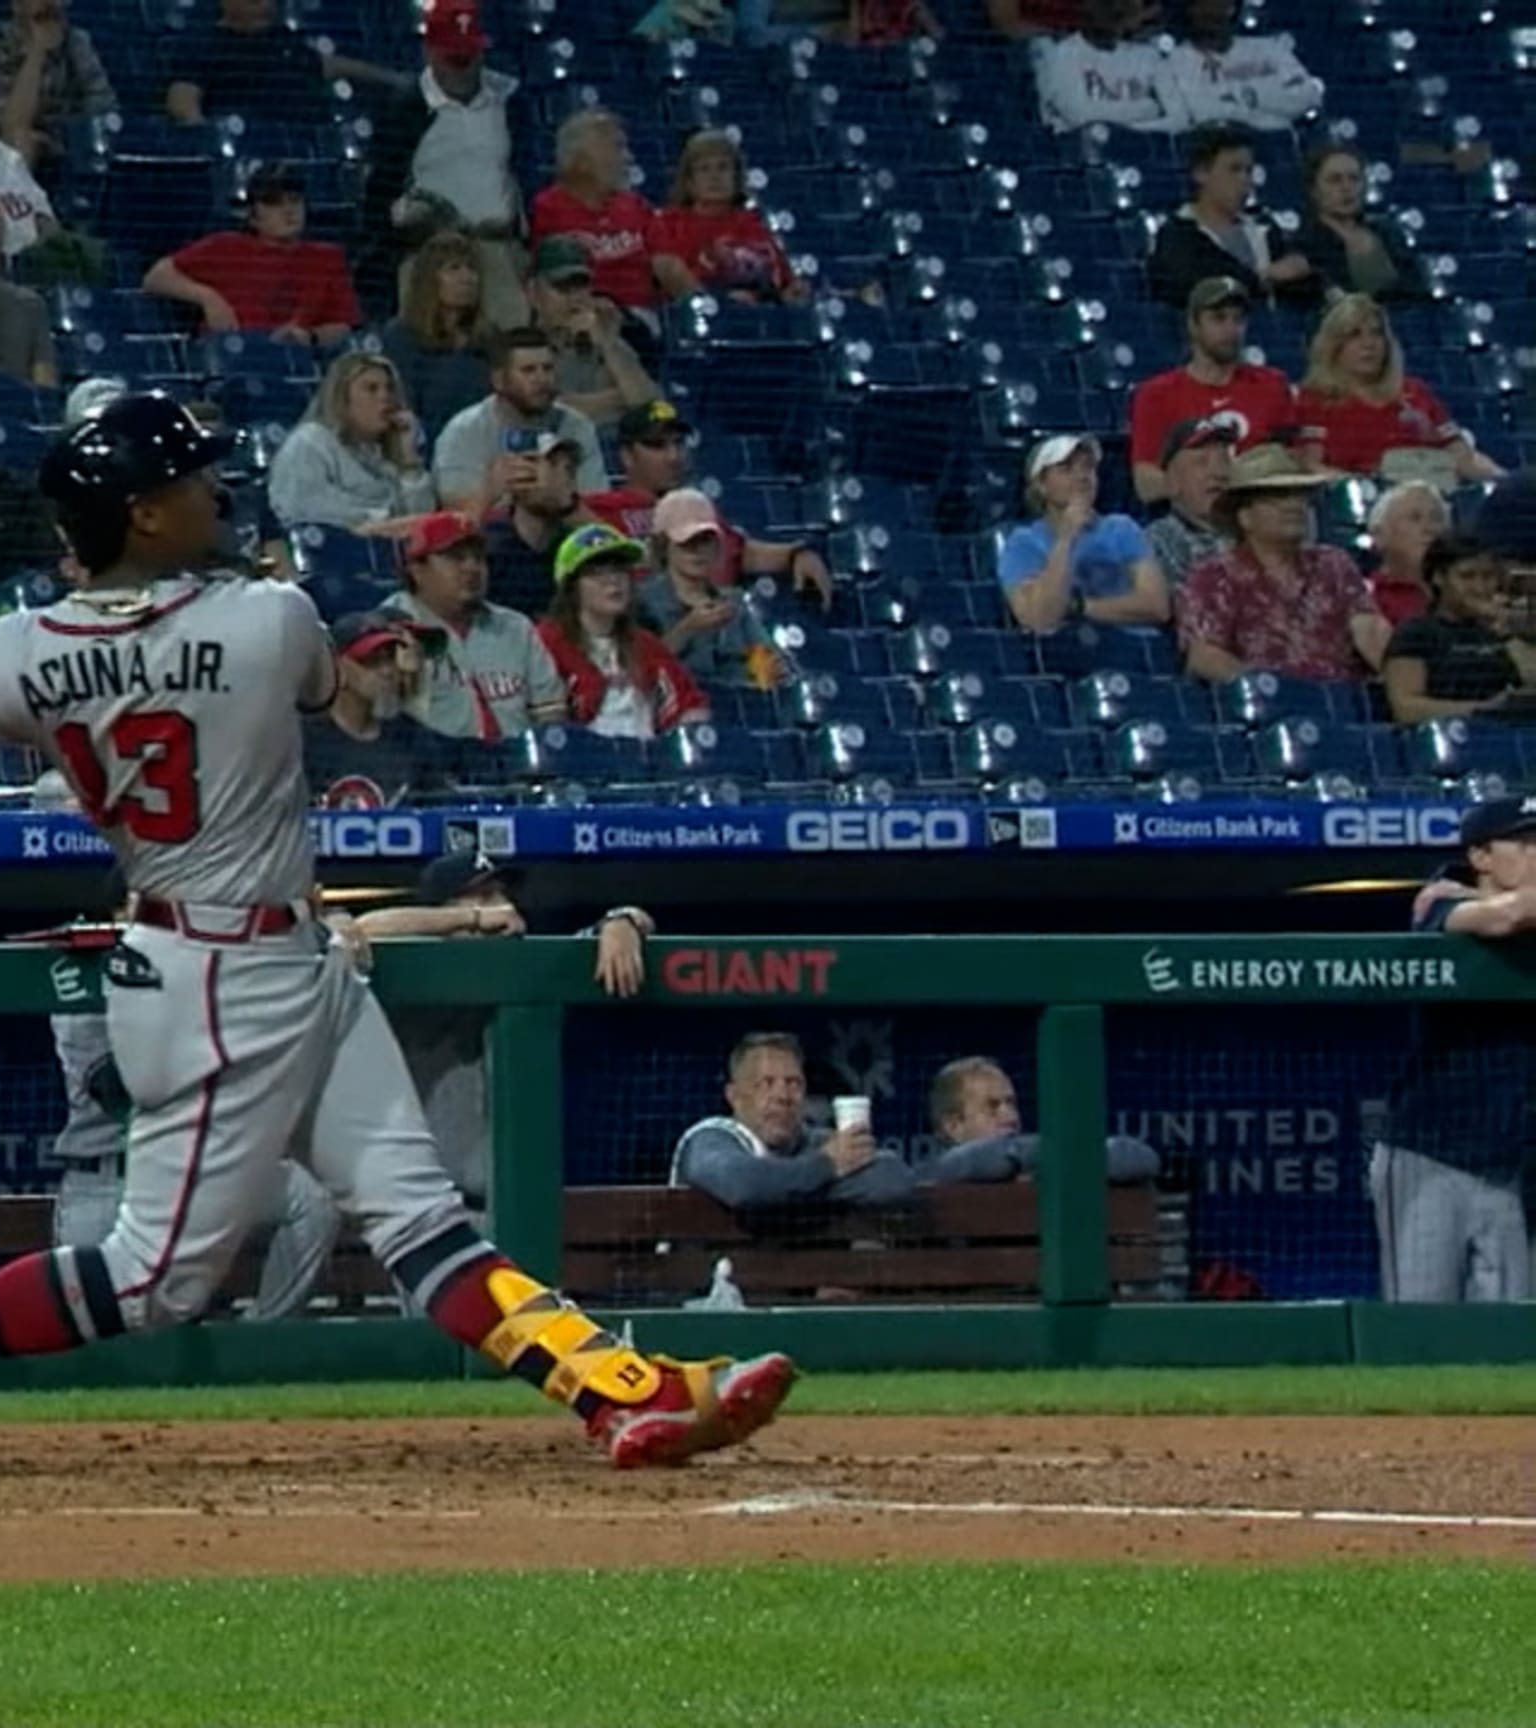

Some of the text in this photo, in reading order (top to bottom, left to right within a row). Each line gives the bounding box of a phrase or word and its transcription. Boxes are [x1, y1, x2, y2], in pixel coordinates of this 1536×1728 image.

[18, 638, 231, 720] ACUÑA JR.
[52, 708, 202, 846] 13
[52, 831, 111, 853] Citize
[602, 823, 762, 850] Citizens Bank Park
[785, 809, 970, 852] GEICO
[1143, 815, 1301, 840] Citizens Bank Park
[1322, 808, 1462, 848] GEIC
[663, 949, 838, 995] GIANT
[1191, 960, 1303, 989] ENERGY
[1314, 957, 1457, 988] TRANSFER
[1118, 1107, 1341, 1148] UNITED
[616, 1361, 647, 1389] 13
